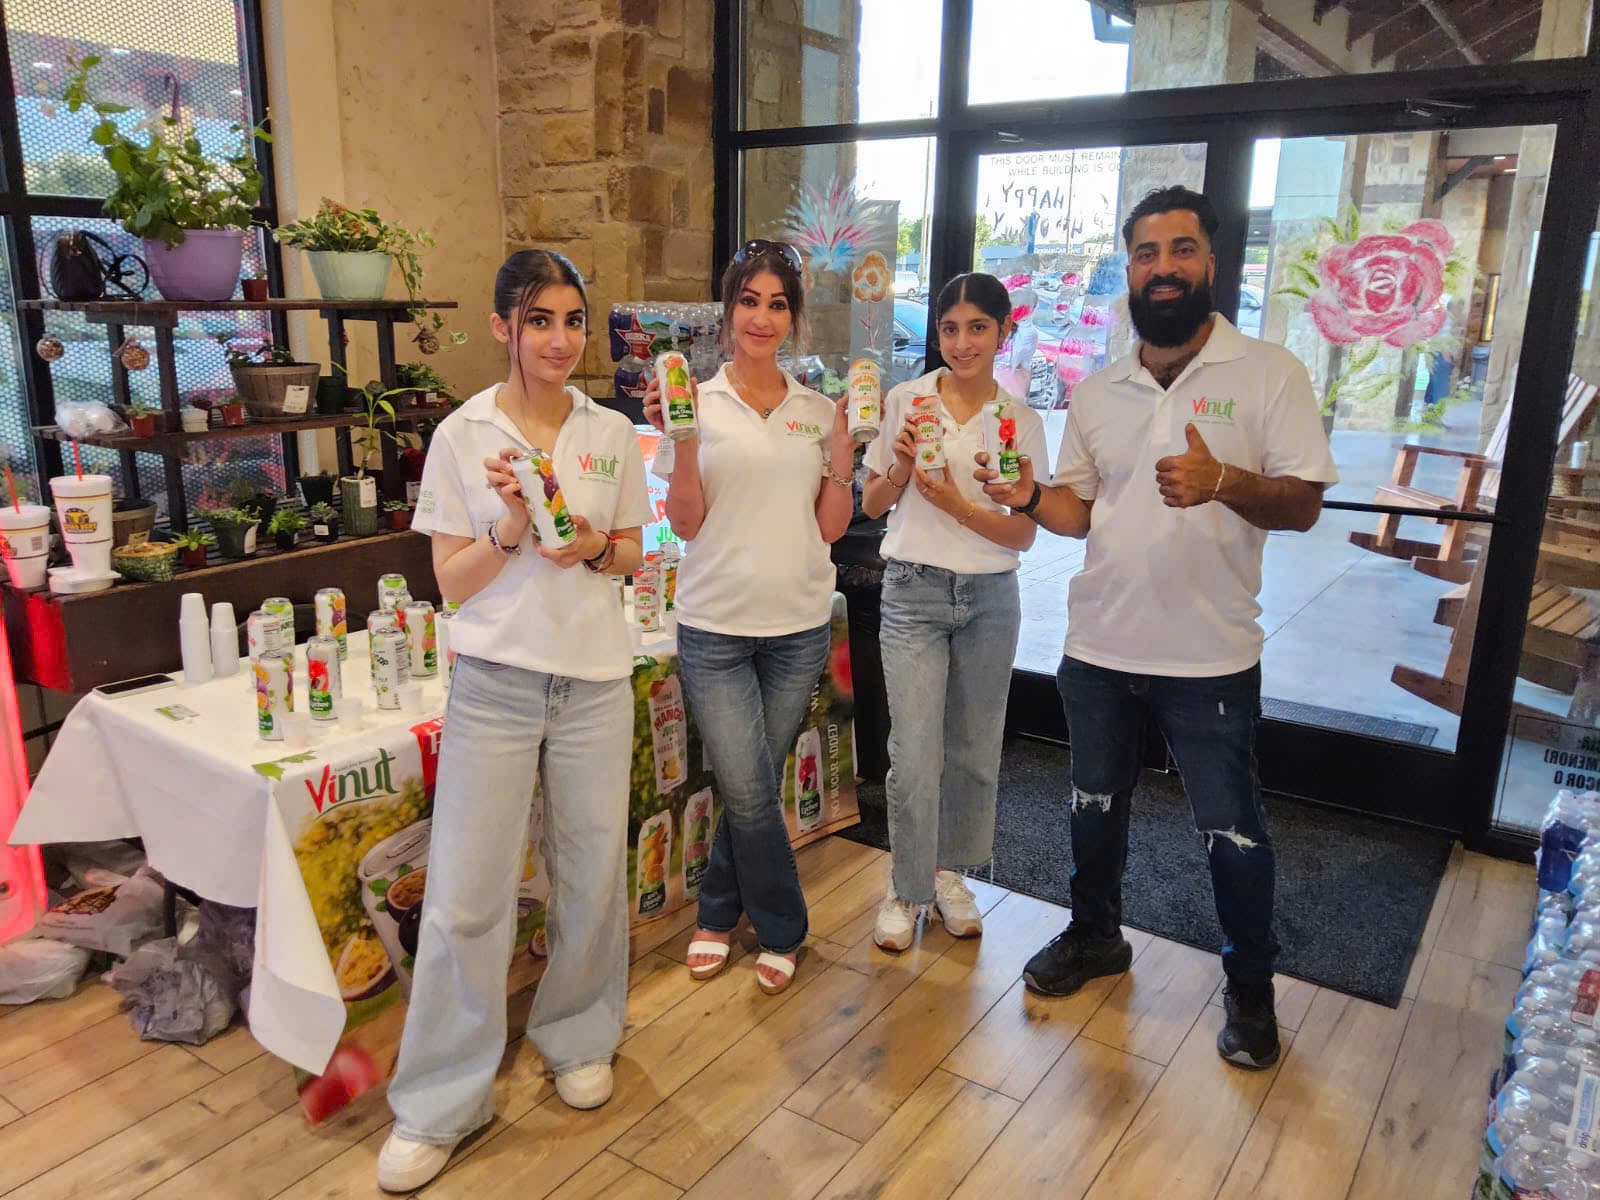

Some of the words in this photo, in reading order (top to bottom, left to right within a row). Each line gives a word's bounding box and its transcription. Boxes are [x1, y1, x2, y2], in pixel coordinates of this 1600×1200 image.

[991, 156, 1011, 166] THIS
[1015, 154, 1044, 165] DOOR
[1049, 152, 1076, 163] MUST
[1081, 150, 1121, 161] REMAIN
[1008, 167, 1038, 176] WHILE
[1042, 164, 1088, 175] BUILDING
[1093, 163, 1104, 172] IS
[1192, 394, 1237, 420] Vinut
[785, 420, 822, 436] Vinut
[577, 453, 620, 480] Vinut
[827, 724, 839, 759] ADDED
[304, 748, 400, 814] Vinut
[830, 761, 840, 799] SUGAR
